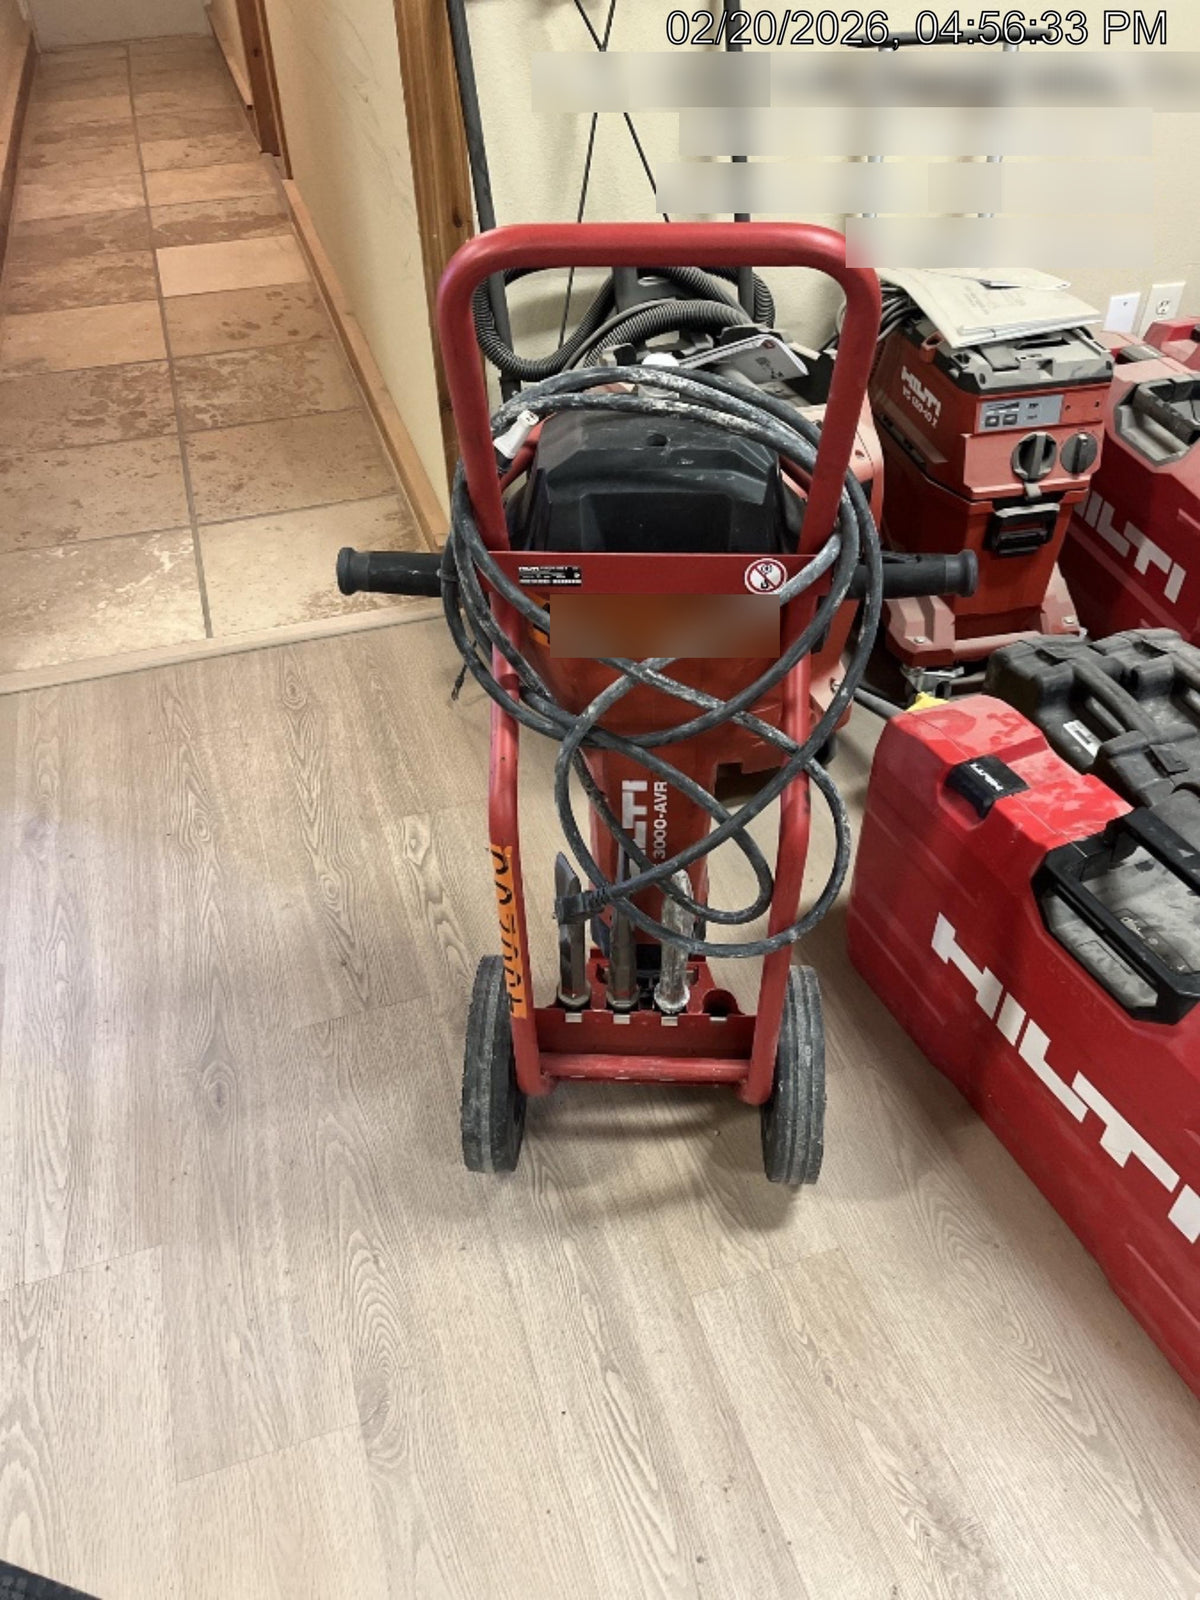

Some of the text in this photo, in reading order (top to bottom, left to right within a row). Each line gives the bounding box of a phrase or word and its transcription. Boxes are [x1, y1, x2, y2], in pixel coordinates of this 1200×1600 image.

[901, 365, 941, 417] HILTI
[622, 780, 648, 877] LTI
[931, 912, 1200, 1244] HILTI
